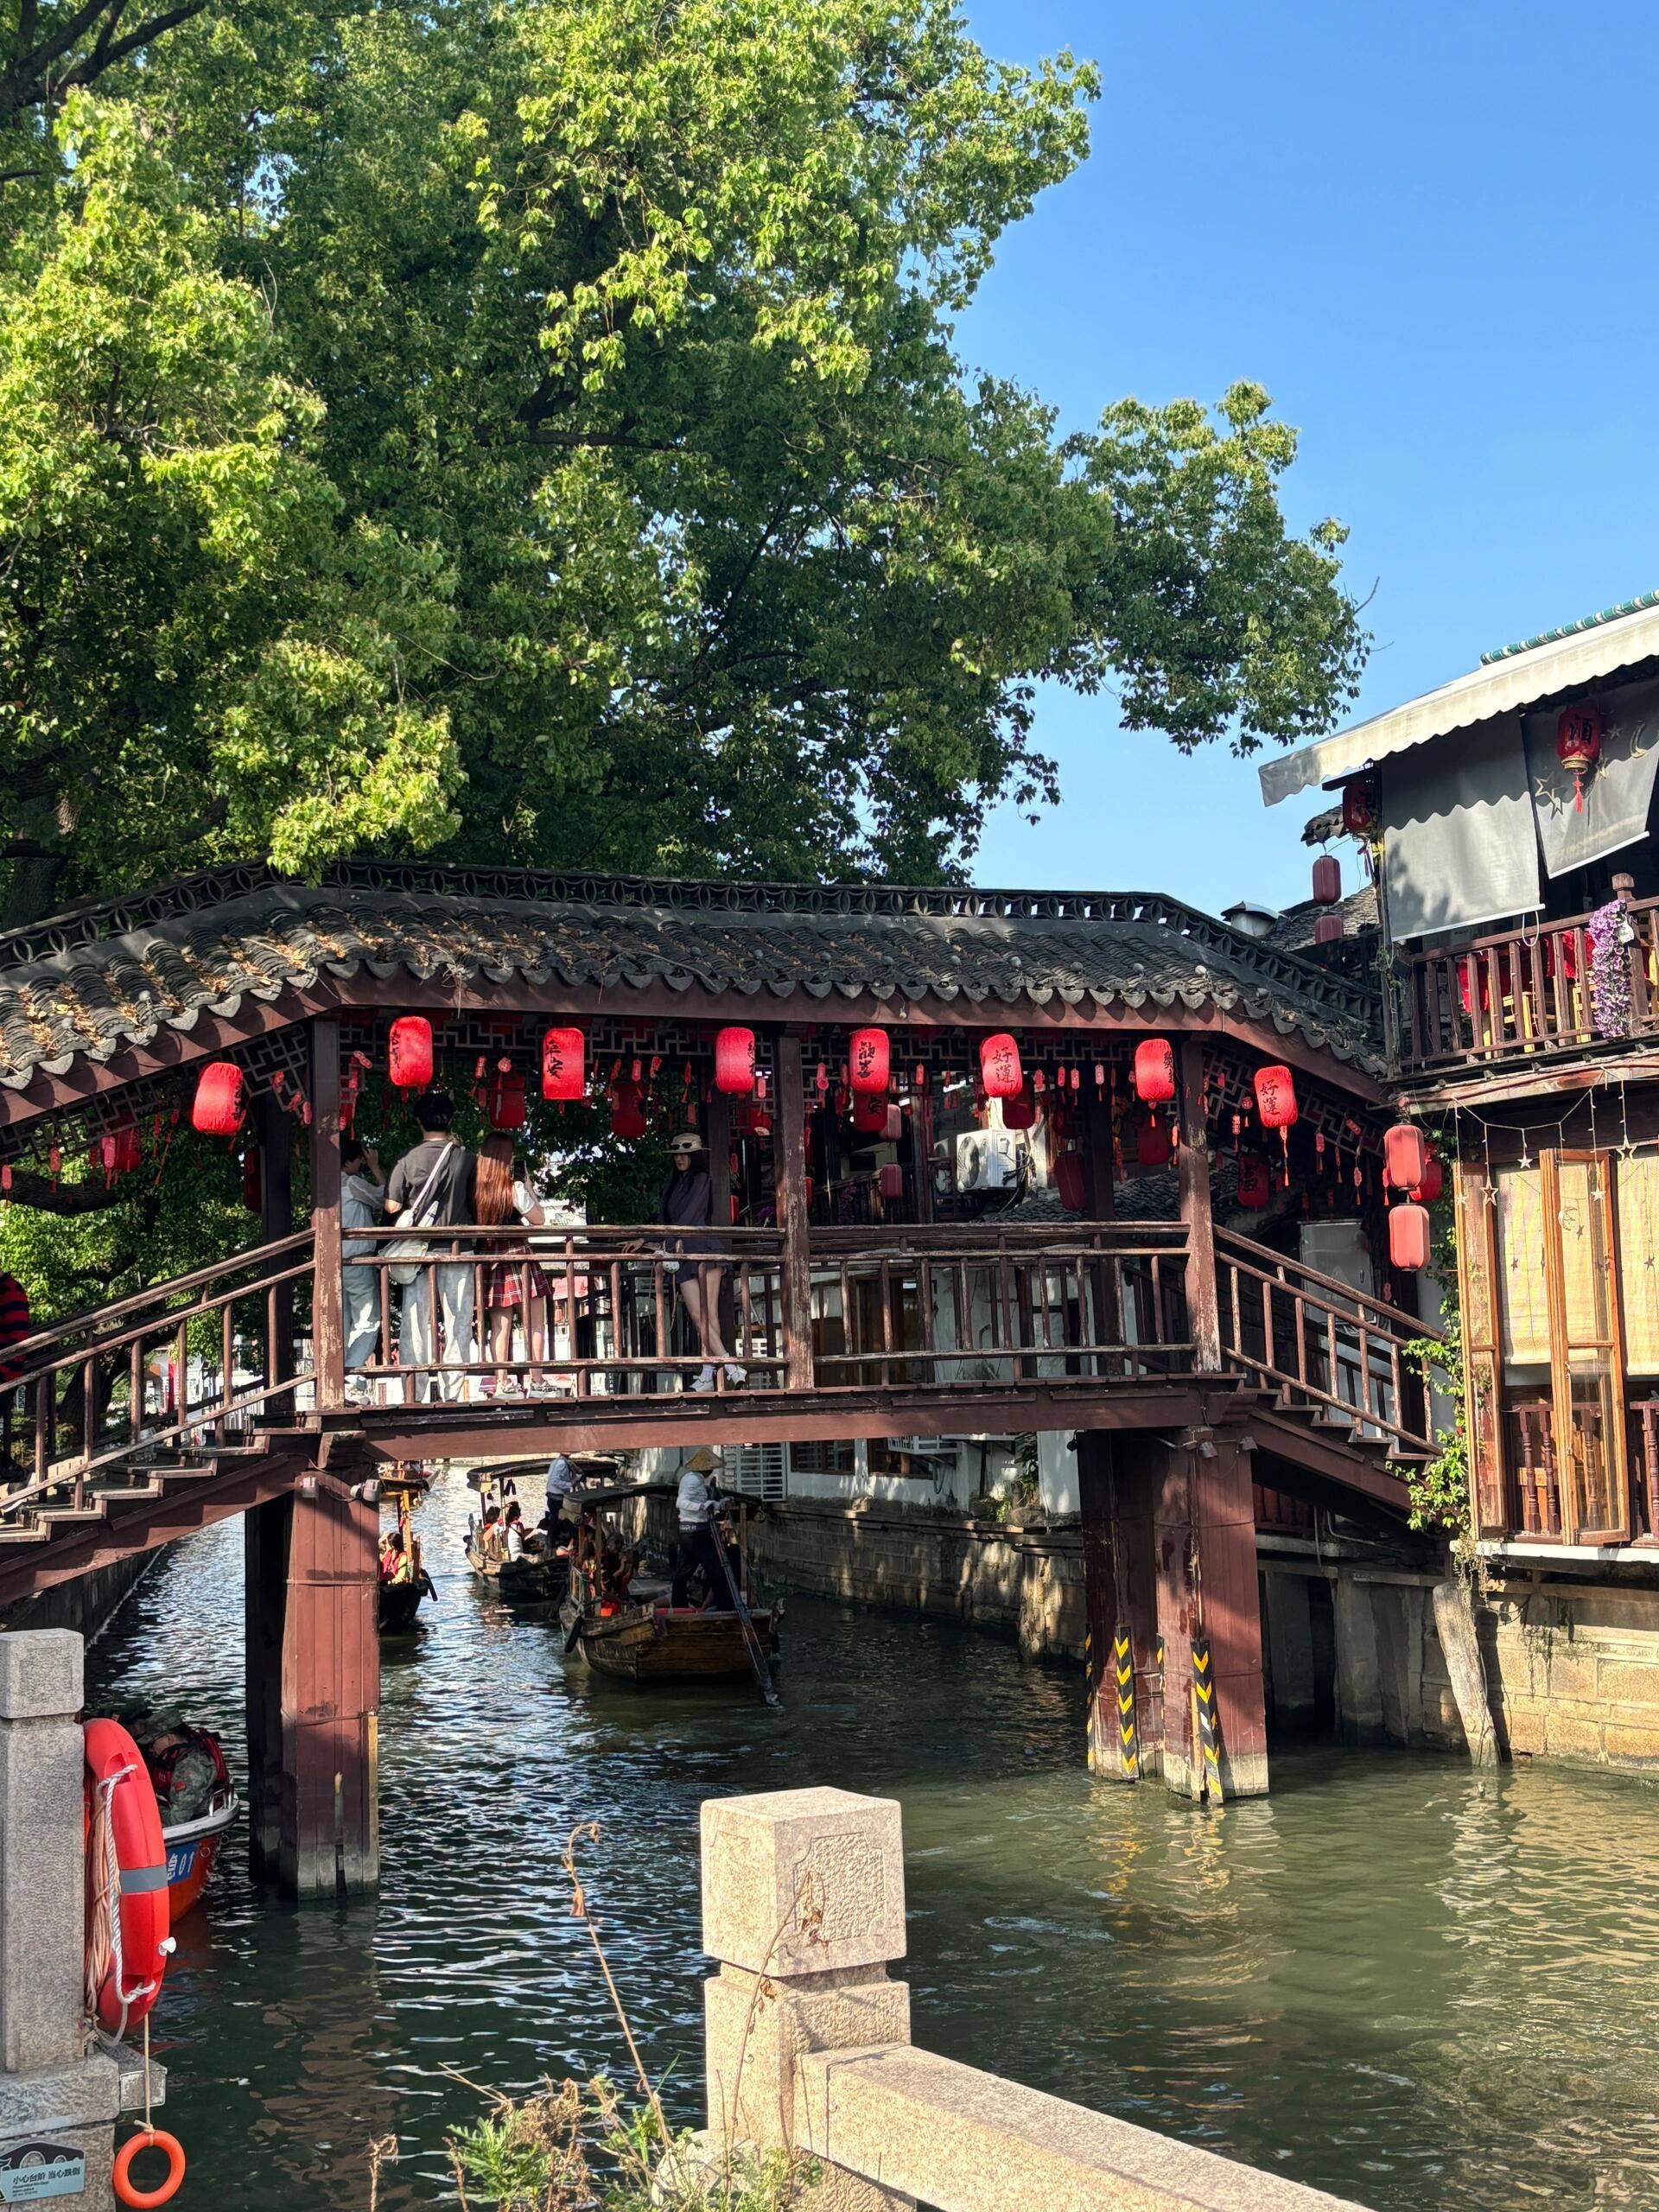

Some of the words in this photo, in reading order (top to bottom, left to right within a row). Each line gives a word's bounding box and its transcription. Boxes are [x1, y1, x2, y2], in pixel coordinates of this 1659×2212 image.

[1568, 714, 1593, 745] 酒
[545, 1039, 563, 1079] 平安
[992, 1046, 1015, 1083] 好運
[1260, 1079, 1281, 1116] 好運
[13, 2171, 46, 2184] 小心台阶
